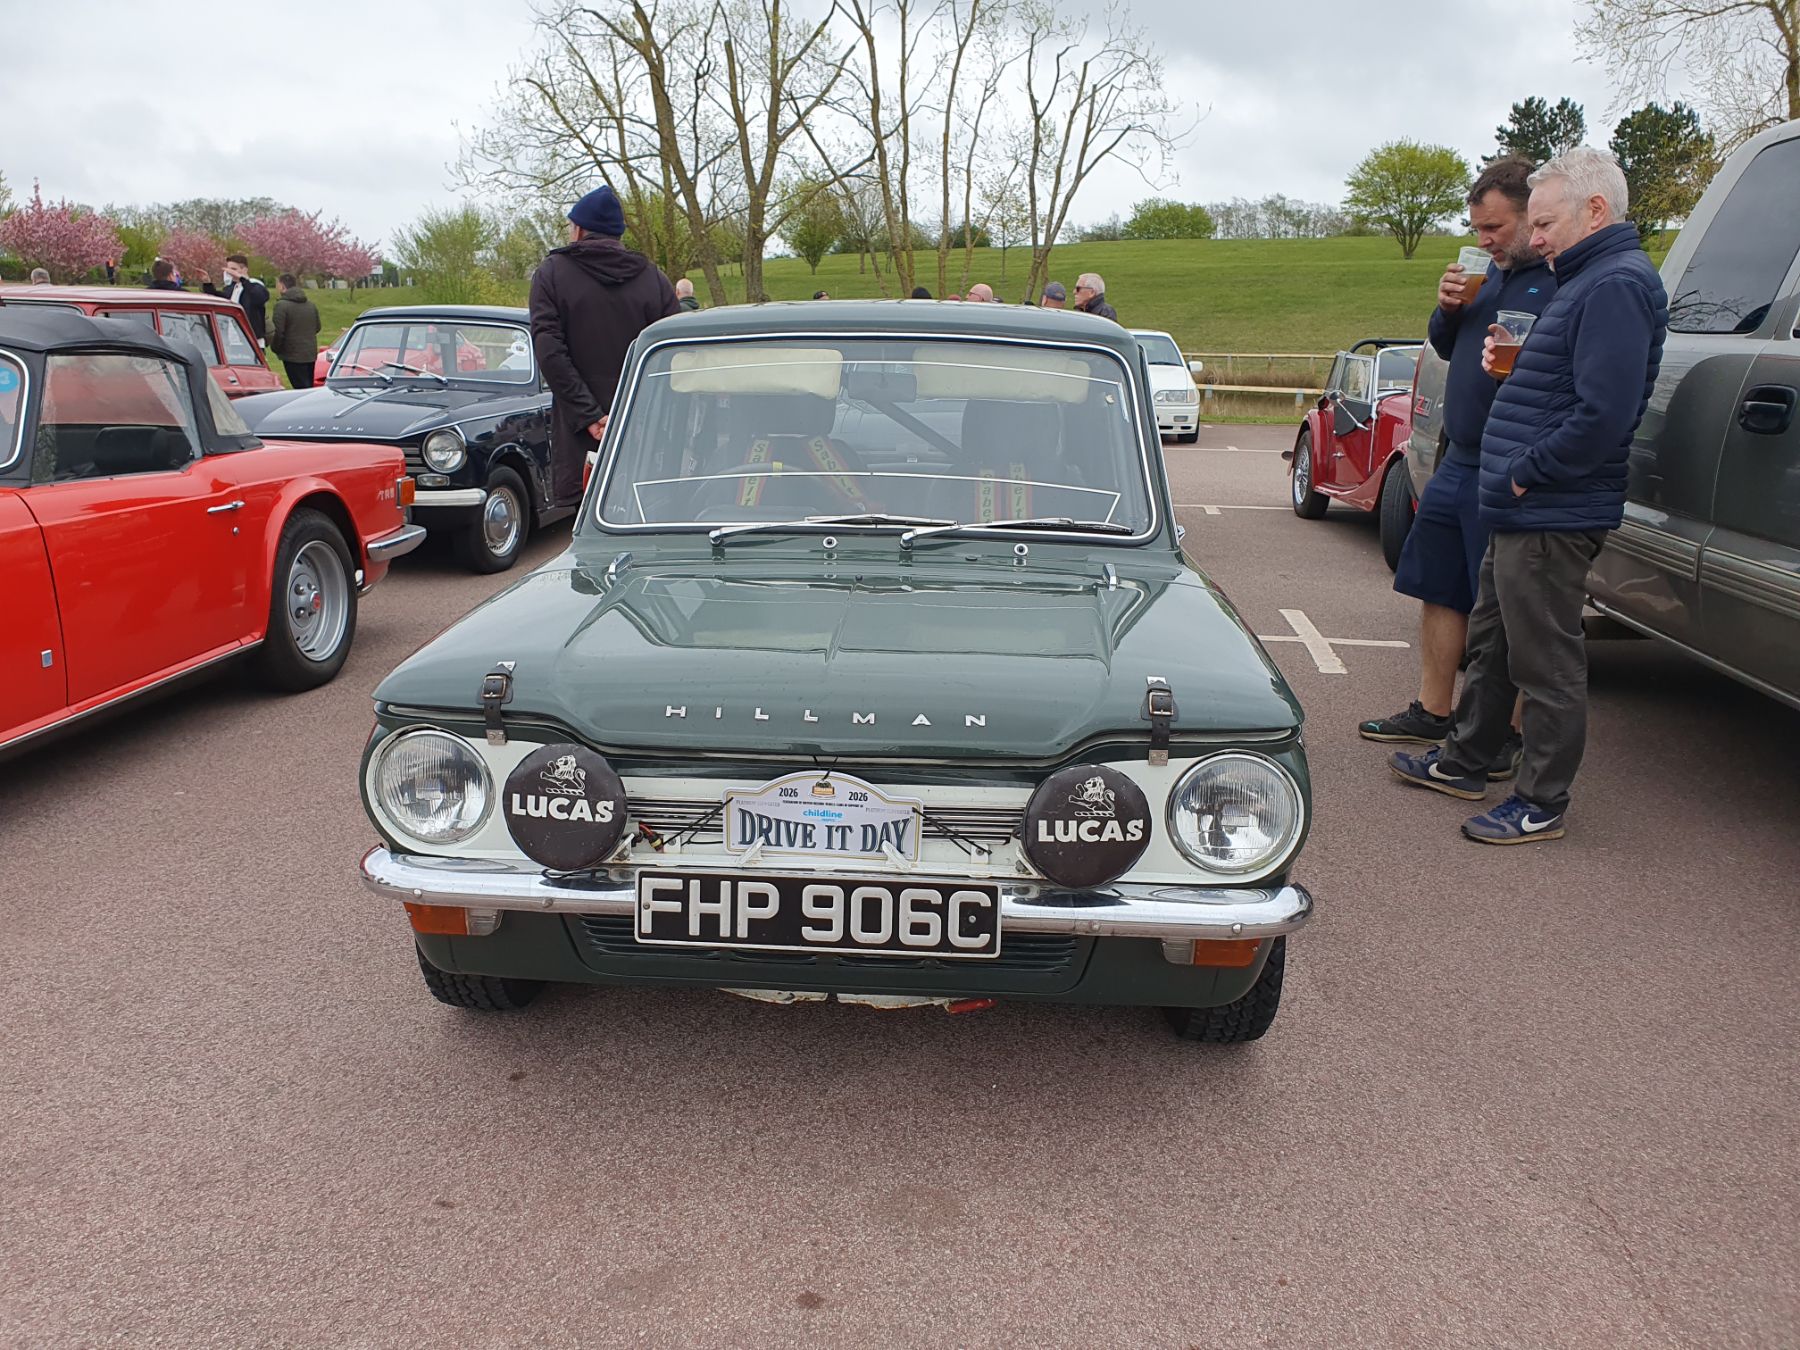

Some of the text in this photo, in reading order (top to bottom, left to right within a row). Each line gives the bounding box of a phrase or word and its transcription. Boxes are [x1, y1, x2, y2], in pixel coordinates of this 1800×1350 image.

[743, 443, 766, 506] Saelt
[665, 705, 987, 728] HILLMAN
[511, 793, 615, 824] LUCAS
[778, 787, 869, 803] 2026 2026
[802, 808, 843, 819] childline
[738, 807, 911, 854] DRIVE IT DAY
[1037, 818, 1144, 843] LUCAS
[640, 877, 993, 950] FHP 906C
